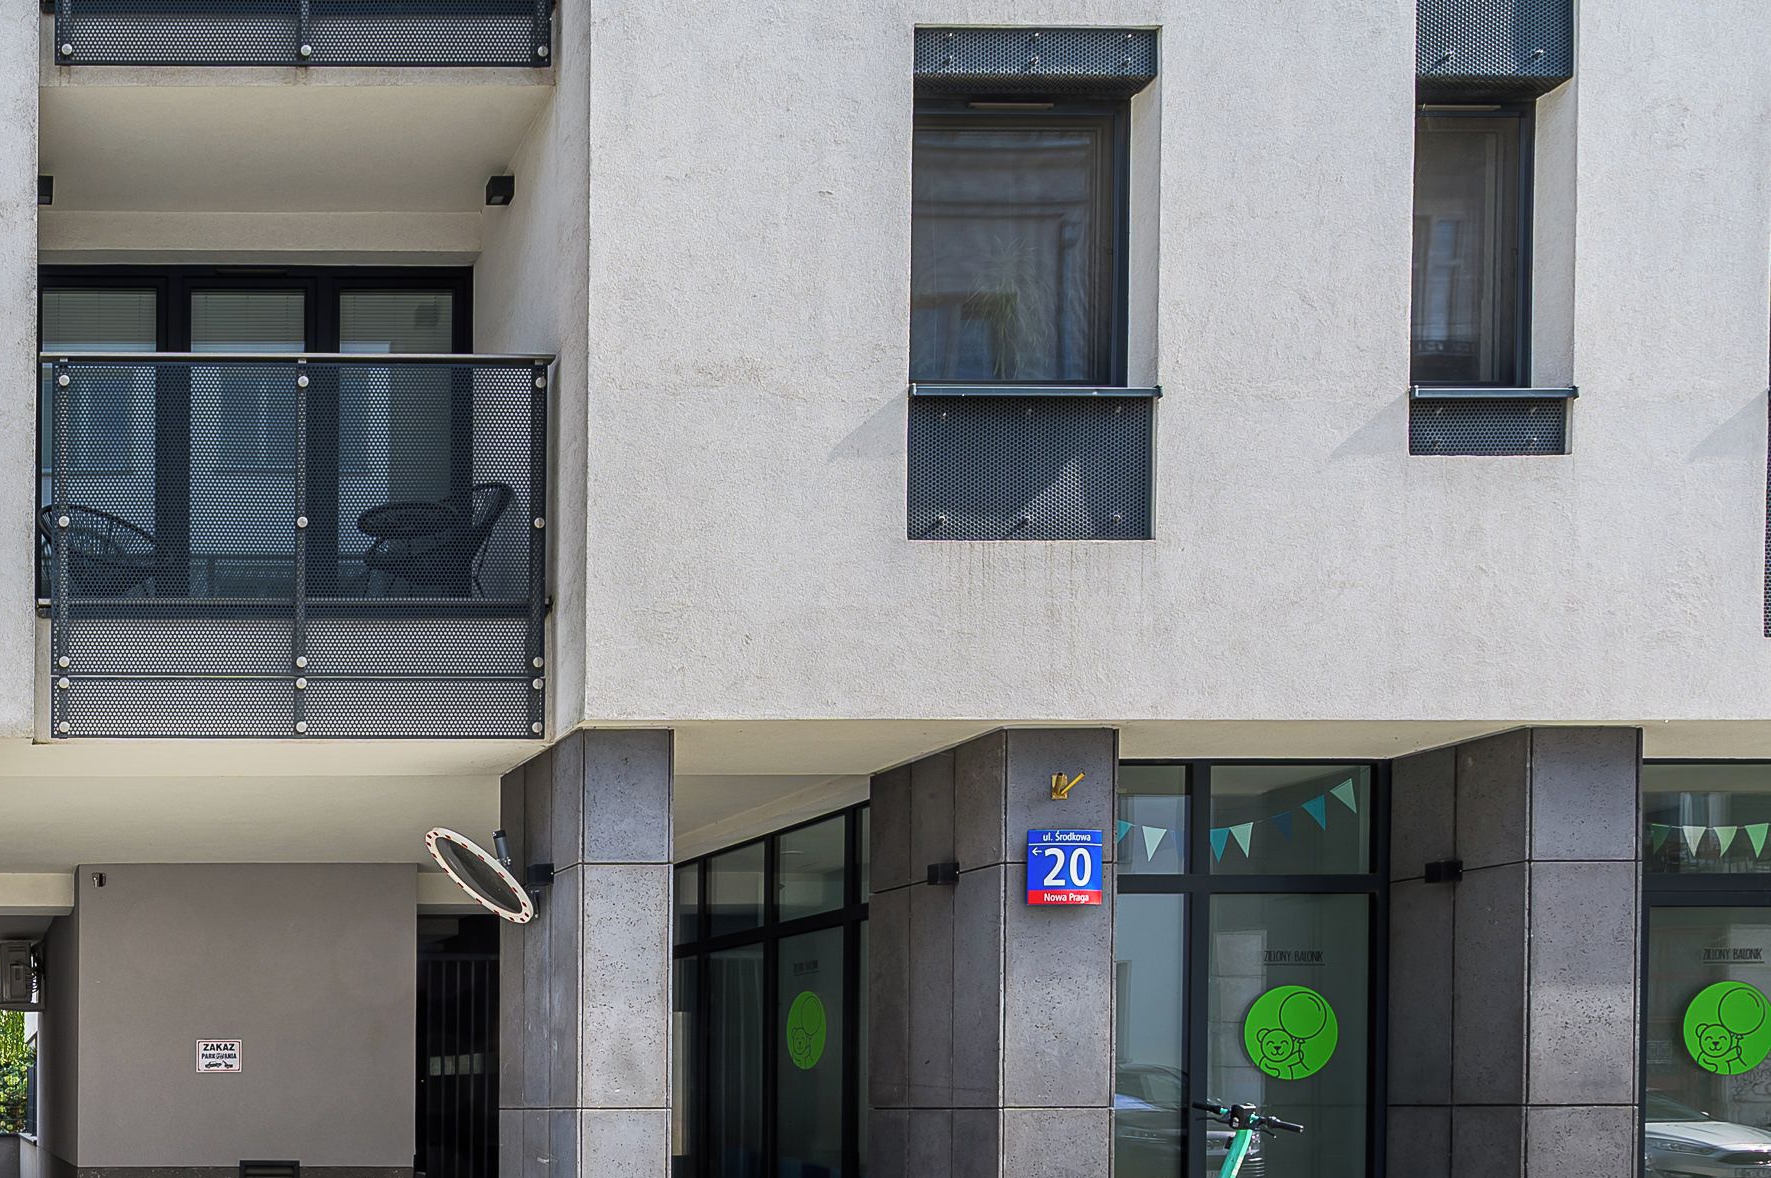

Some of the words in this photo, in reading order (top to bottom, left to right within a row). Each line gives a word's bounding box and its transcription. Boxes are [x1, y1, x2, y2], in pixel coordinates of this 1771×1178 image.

[1042, 832, 1053, 841] ul.
[1055, 830, 1091, 841] Środkowa
[1043, 847, 1092, 887] 20
[1043, 893, 1067, 902] Nowa
[1068, 893, 1090, 904] Praga
[202, 1043, 236, 1052] ZAKAZ
